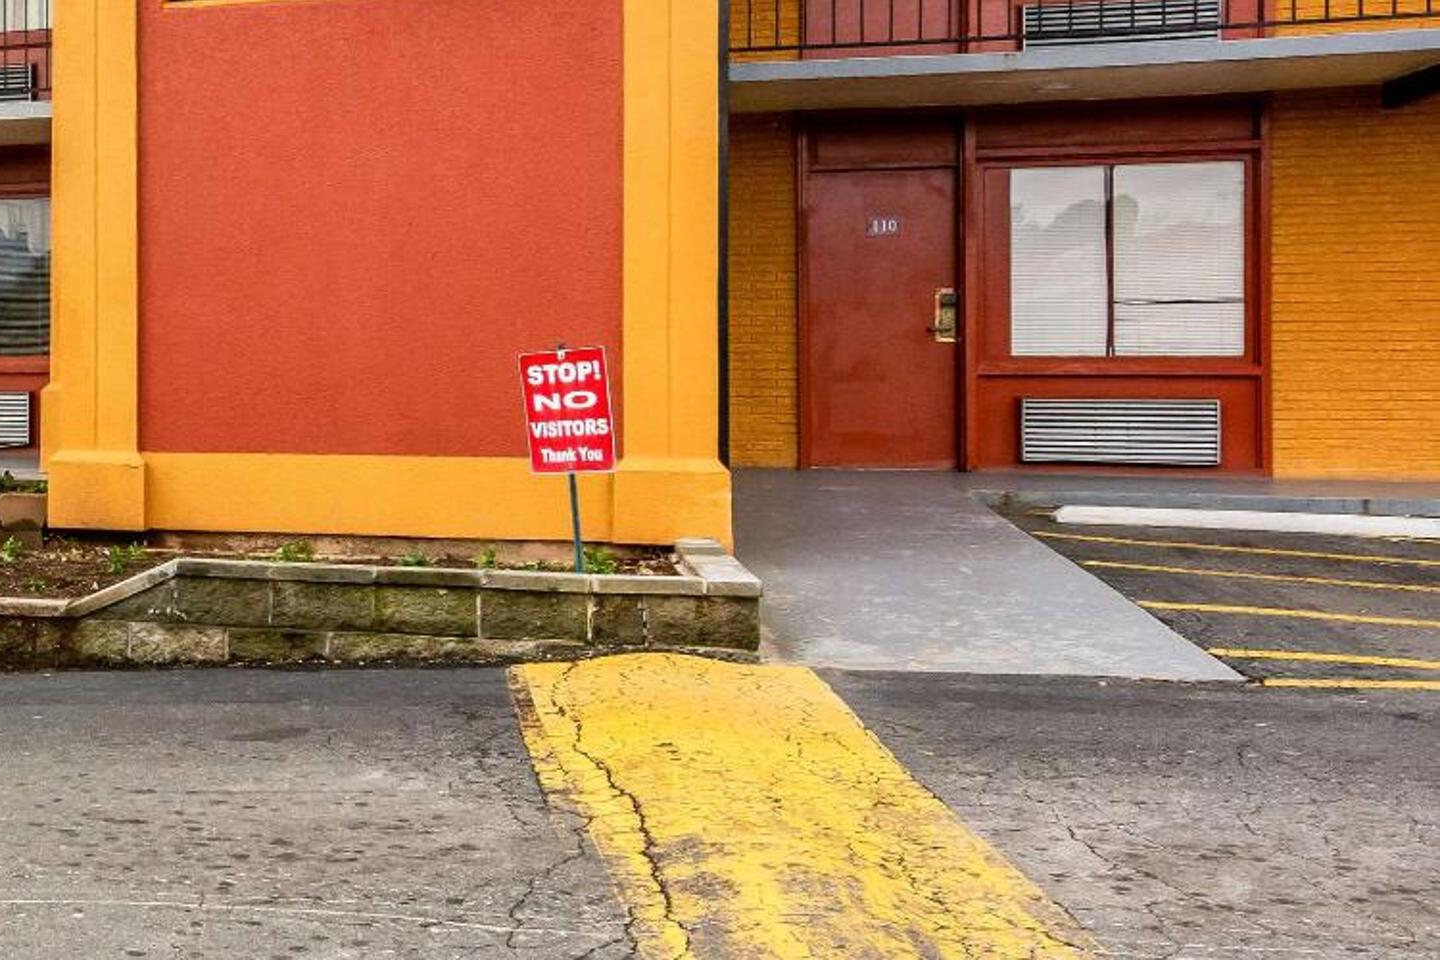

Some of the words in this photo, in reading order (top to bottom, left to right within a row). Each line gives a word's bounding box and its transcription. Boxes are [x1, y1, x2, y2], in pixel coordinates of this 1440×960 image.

[526, 360, 602, 386] STOP!
[532, 390, 598, 412] NO
[529, 418, 610, 439] VISITORS
[541, 448, 577, 463] Thank
[578, 446, 604, 462] You
